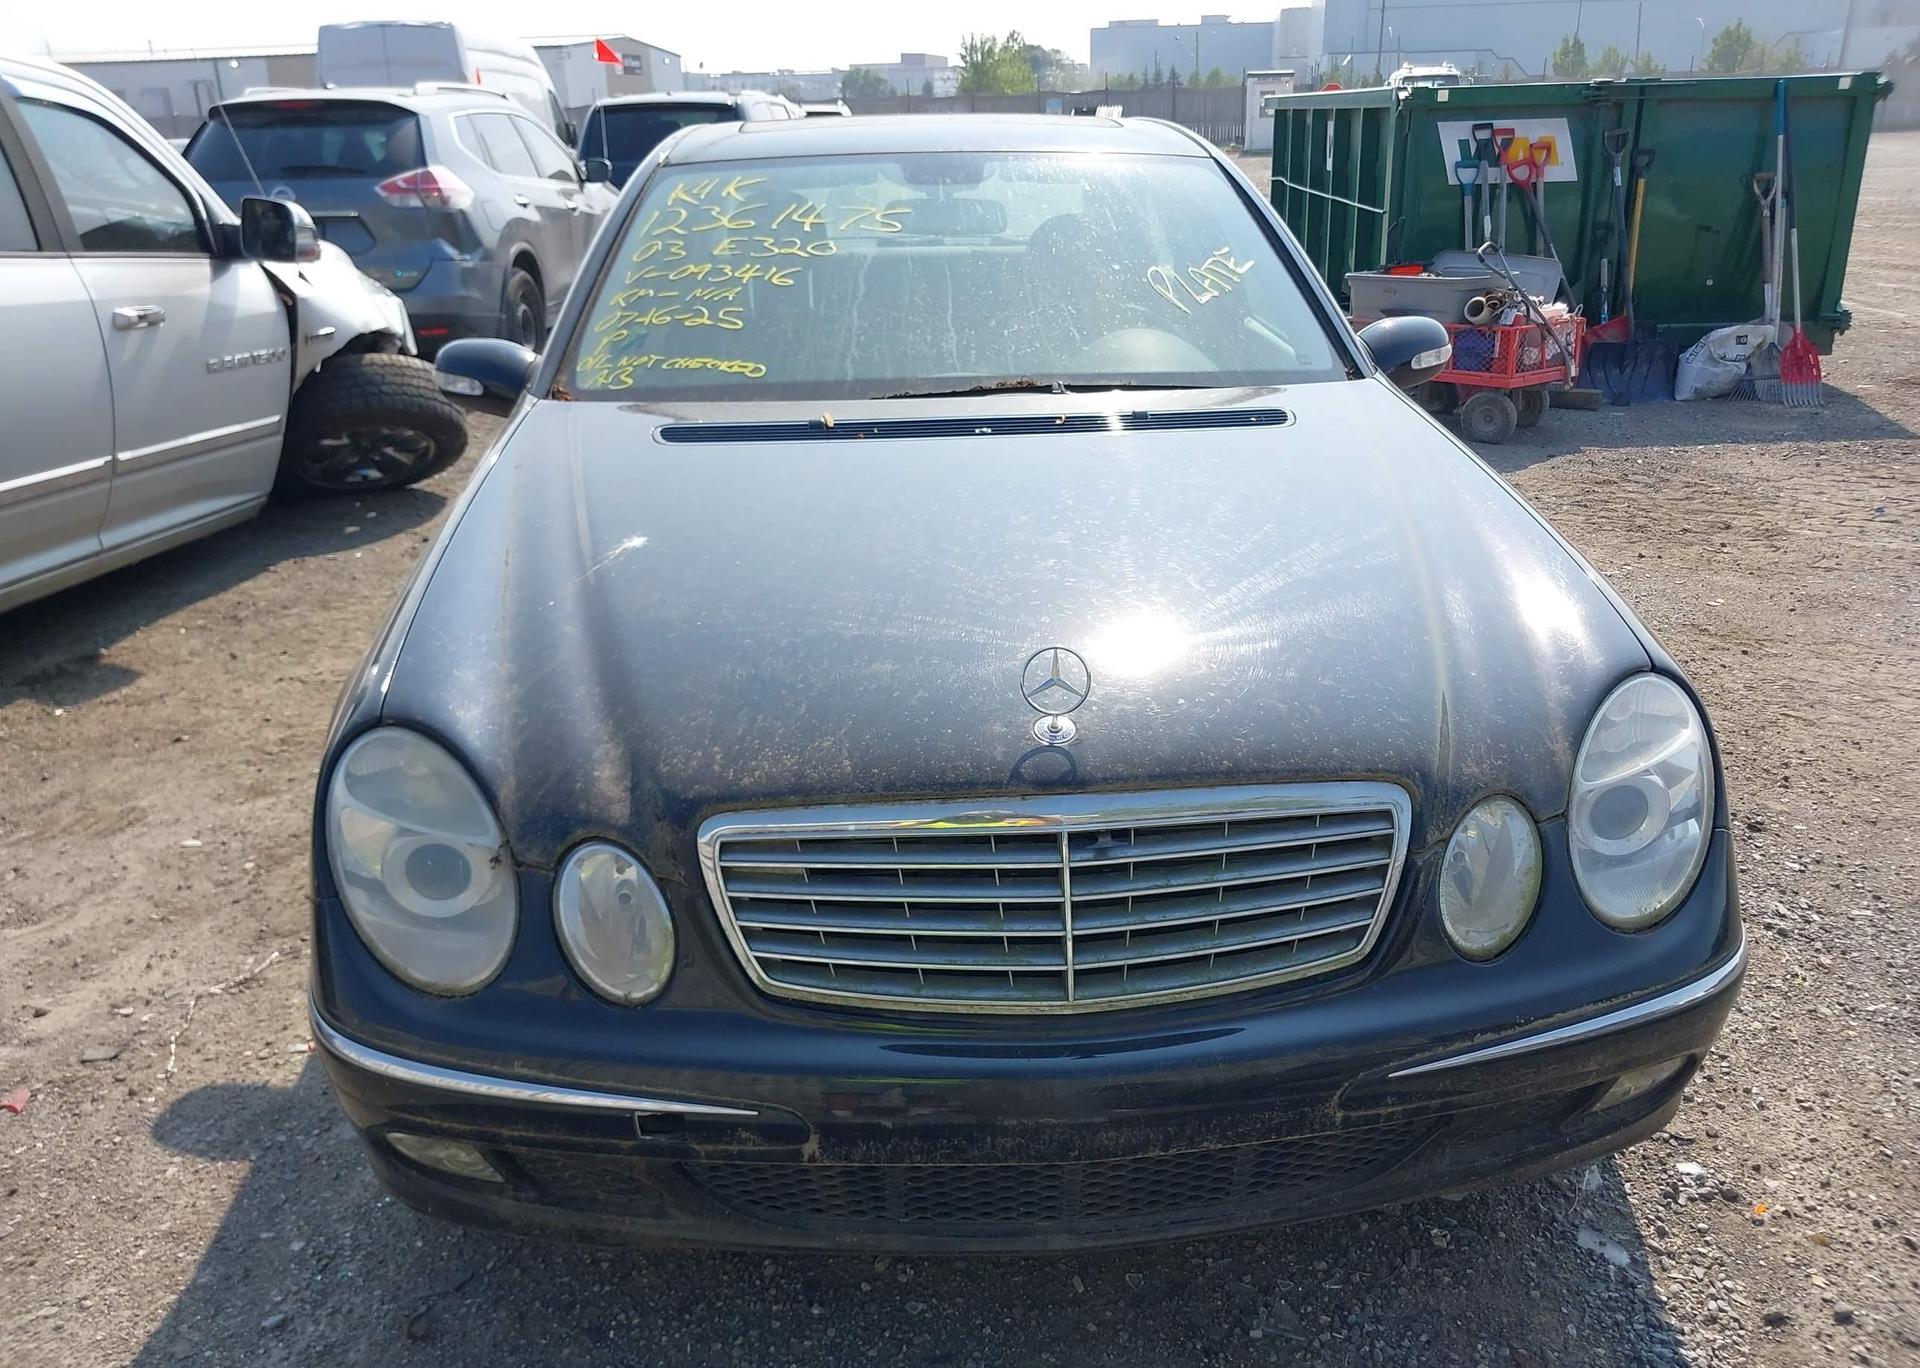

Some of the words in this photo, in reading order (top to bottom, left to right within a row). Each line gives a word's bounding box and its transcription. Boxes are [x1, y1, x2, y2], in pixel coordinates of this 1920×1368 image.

[633, 241, 688, 262] 03
[712, 236, 838, 258] E320
[1147, 246, 1255, 316] PLATE
[617, 354, 666, 369] NOT
